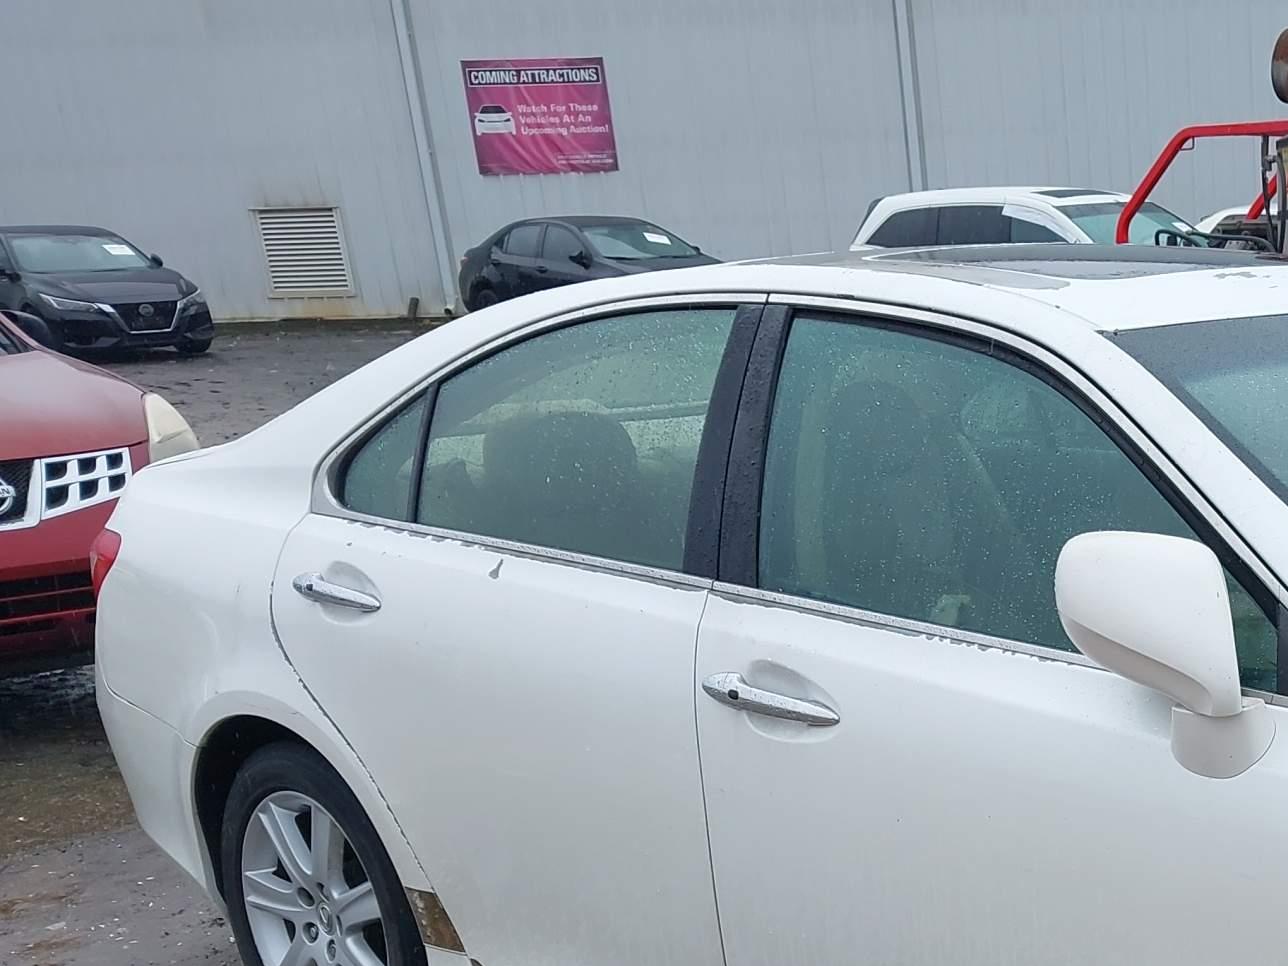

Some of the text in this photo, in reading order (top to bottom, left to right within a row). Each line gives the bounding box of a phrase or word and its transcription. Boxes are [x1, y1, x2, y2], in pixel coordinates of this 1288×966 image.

[470, 68, 598, 84] COMING ATTRACTIONS
[516, 103, 599, 113] Watch For These
[519, 113, 592, 124] Vehicles At An
[521, 124, 609, 136] Upcoming Auction!
